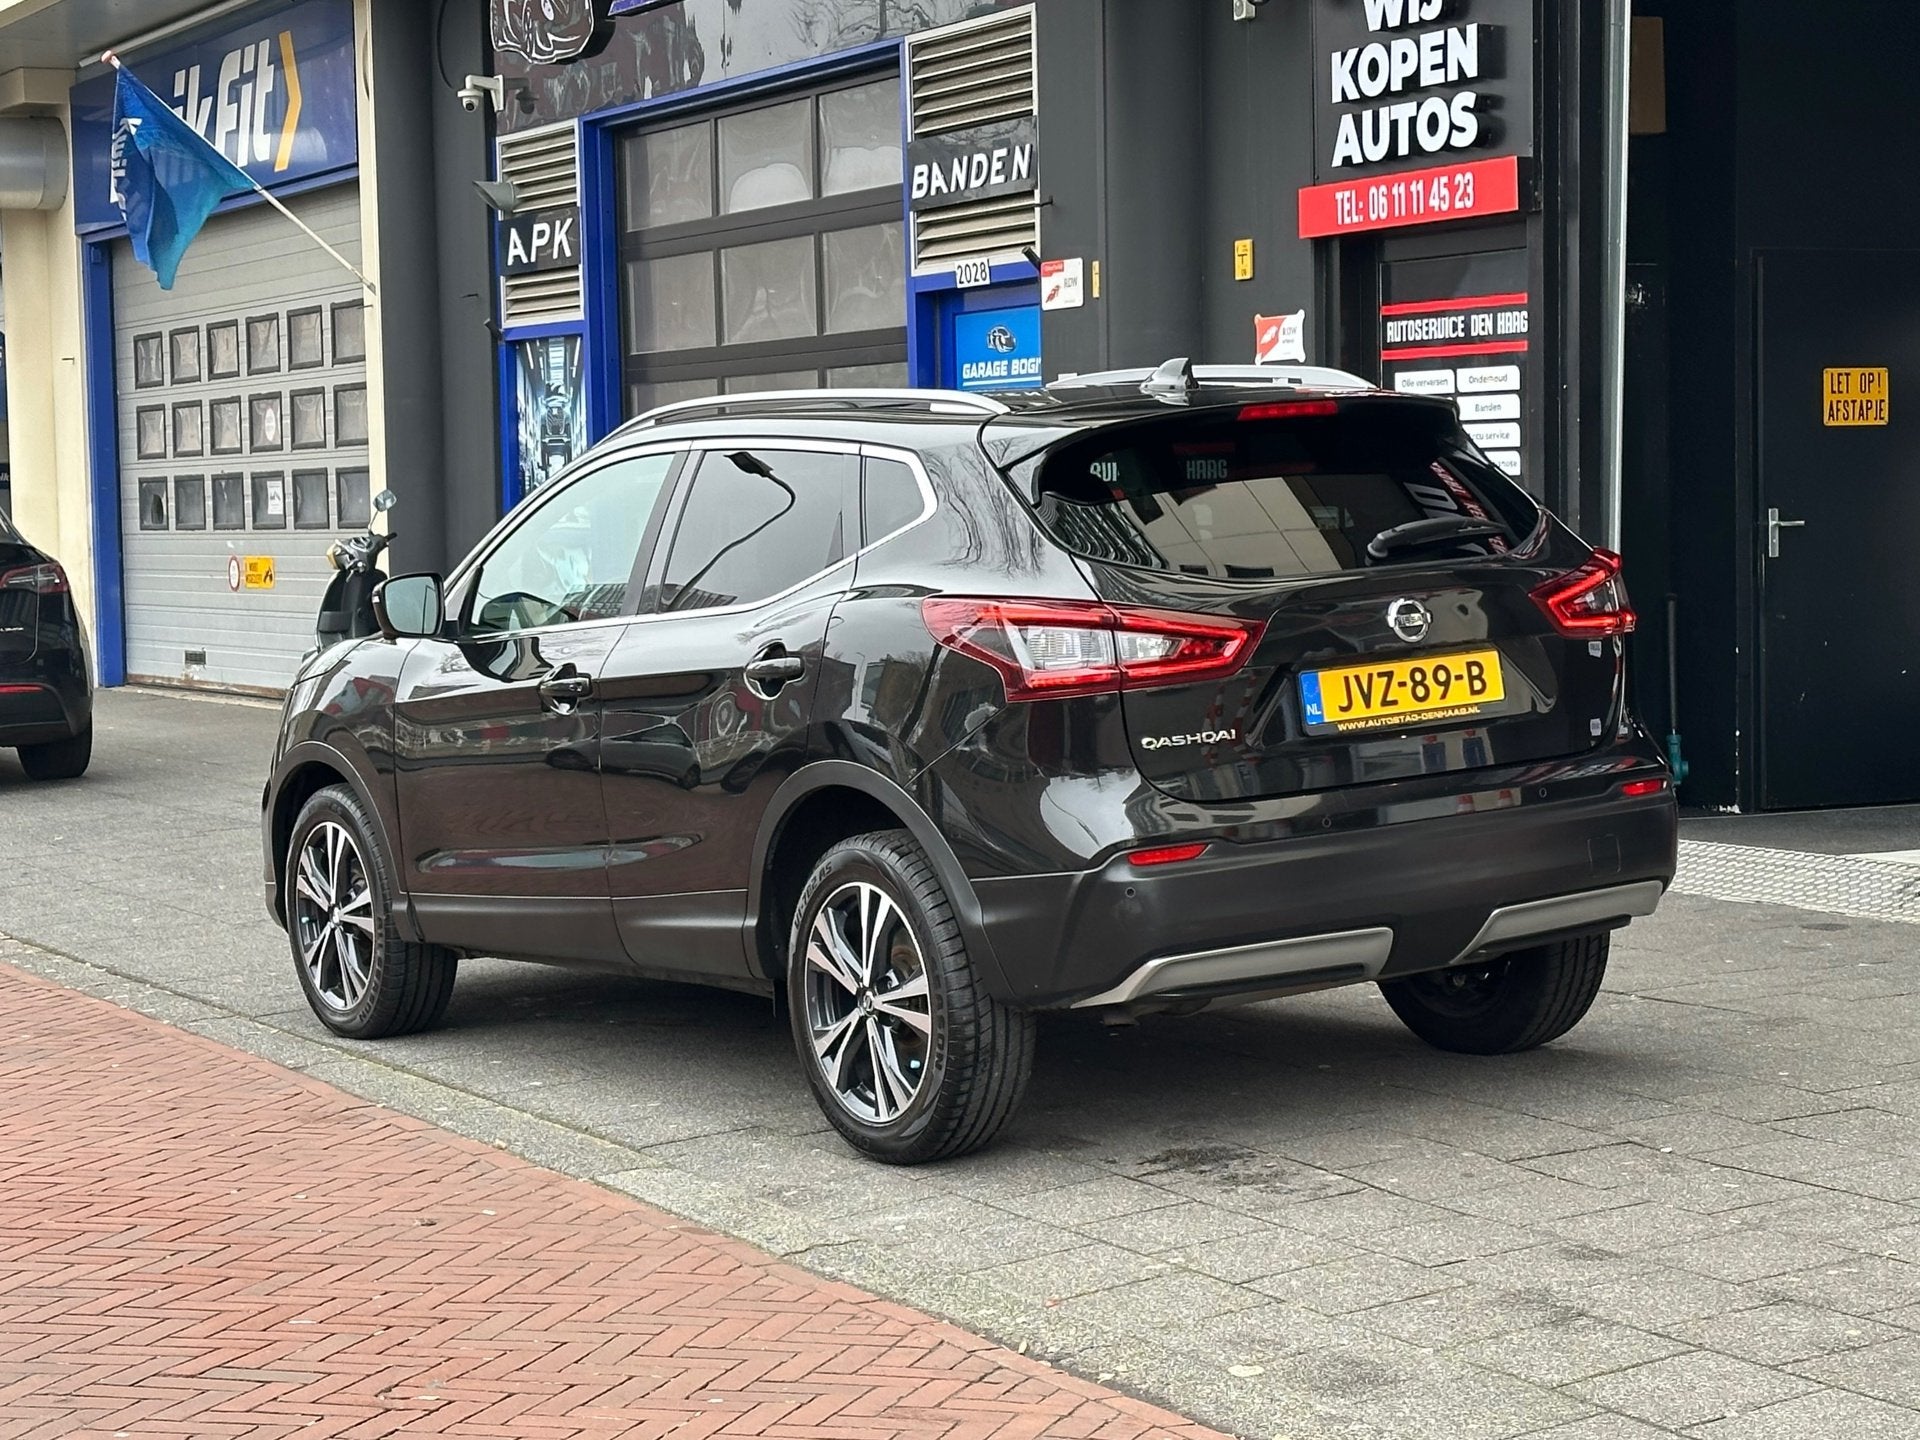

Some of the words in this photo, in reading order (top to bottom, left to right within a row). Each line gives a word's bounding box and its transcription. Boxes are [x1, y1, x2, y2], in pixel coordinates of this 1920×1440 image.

[1331, 23, 1478, 103] KOPEN
[1331, 91, 1478, 167] AUTOS
[911, 143, 1032, 199] BANDEN
[1335, 189, 1363, 225] TEL:
[1368, 186, 1388, 221] 06
[1392, 183, 1406, 216] 11
[1410, 180, 1424, 214] 11
[1429, 175, 1448, 211] 45
[1454, 172, 1474, 208] 23
[507, 217, 573, 266] APK
[957, 263, 987, 284] 2028
[1470, 313, 1493, 336] DEN
[1497, 311, 1528, 334] HAAG
[962, 360, 1008, 379] GARAGE
[1830, 372, 1852, 394] LET
[1860, 372, 1881, 393] OP!
[1828, 399, 1885, 422] AFSTAPJE
[1337, 659, 1488, 713] JVZ-89-B
[1306, 703, 1322, 717] NL
[1141, 728, 1236, 751] QASHQAI
